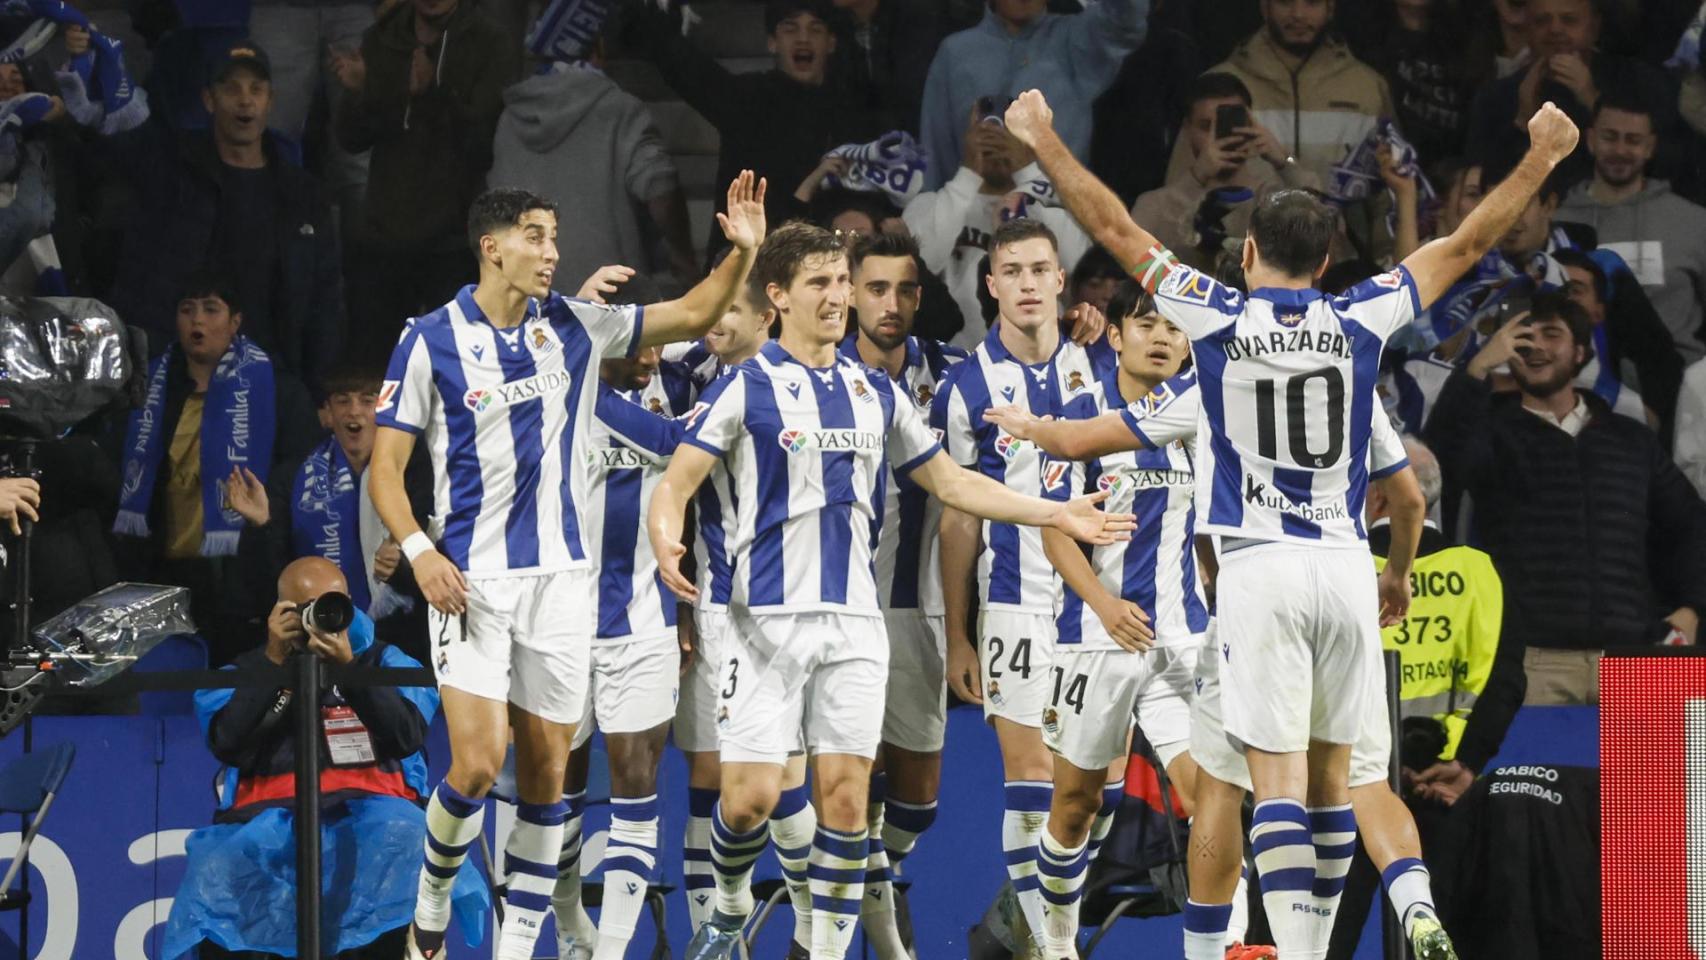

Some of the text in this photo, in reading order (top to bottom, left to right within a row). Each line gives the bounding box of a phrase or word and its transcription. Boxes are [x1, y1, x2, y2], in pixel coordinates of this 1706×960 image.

[1224, 328, 1355, 362] OYARZABAL
[497, 371, 570, 403] YASUDA
[225, 389, 249, 462] Familia
[1255, 366, 1345, 469] 10
[602, 450, 657, 466] YASU
[813, 431, 882, 450] YASUDA
[1246, 473, 1346, 521] kutbank
[315, 521, 342, 567] ilia
[1409, 571, 1465, 598] BICO
[438, 610, 467, 647] 21
[1393, 615, 1452, 645] 373
[988, 636, 1032, 679] 24
[721, 657, 739, 700] 3
[1049, 665, 1089, 715] 14
[517, 916, 537, 928] RS
